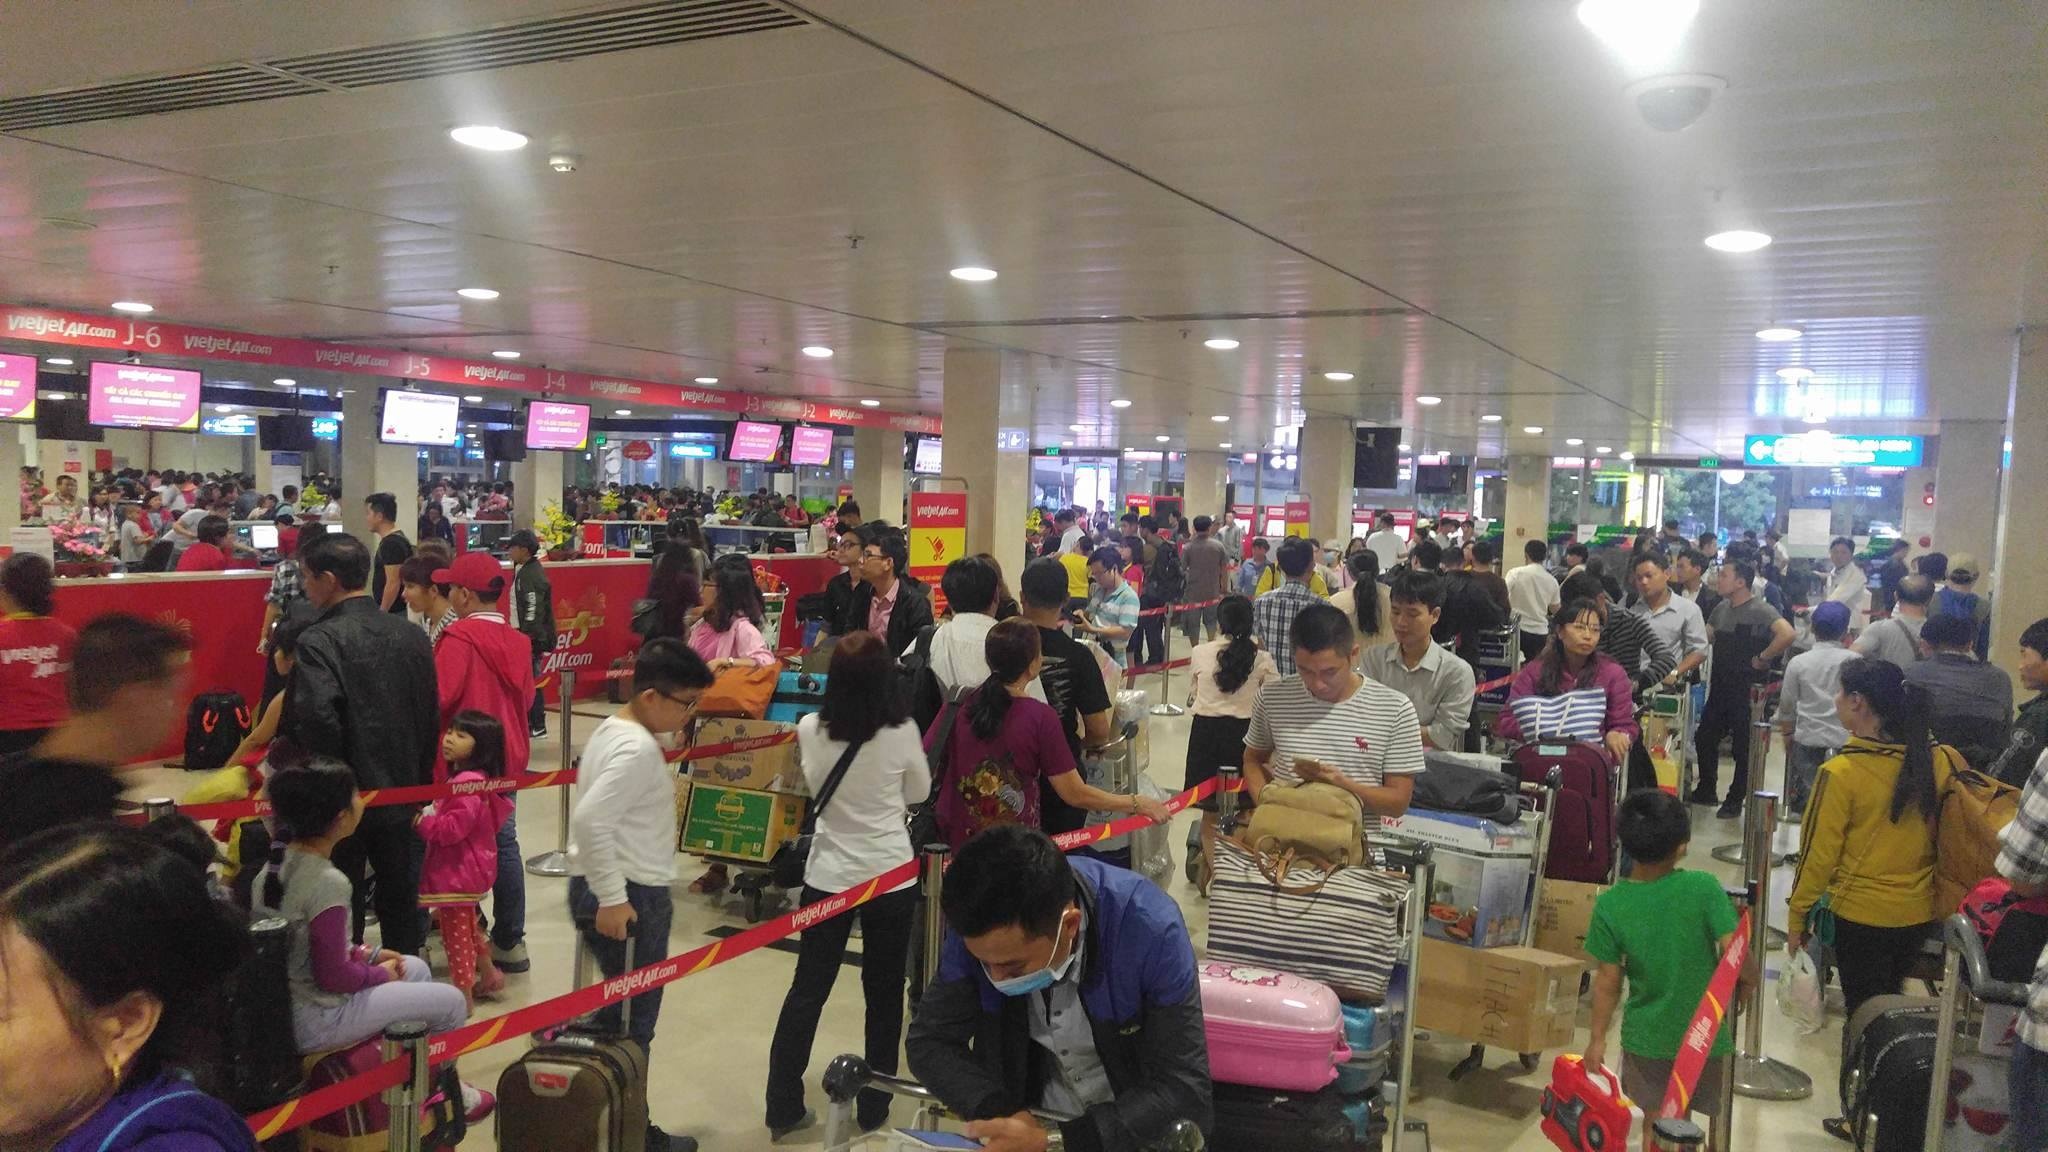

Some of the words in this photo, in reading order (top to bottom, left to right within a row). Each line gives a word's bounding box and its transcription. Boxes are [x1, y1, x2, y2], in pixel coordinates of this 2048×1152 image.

[123, 323, 161, 347] J-6
[404, 356, 430, 375] J-5
[544, 373, 566, 390] J-4
[745, 397, 759, 411] J-3
[802, 403, 816, 417] J-2
